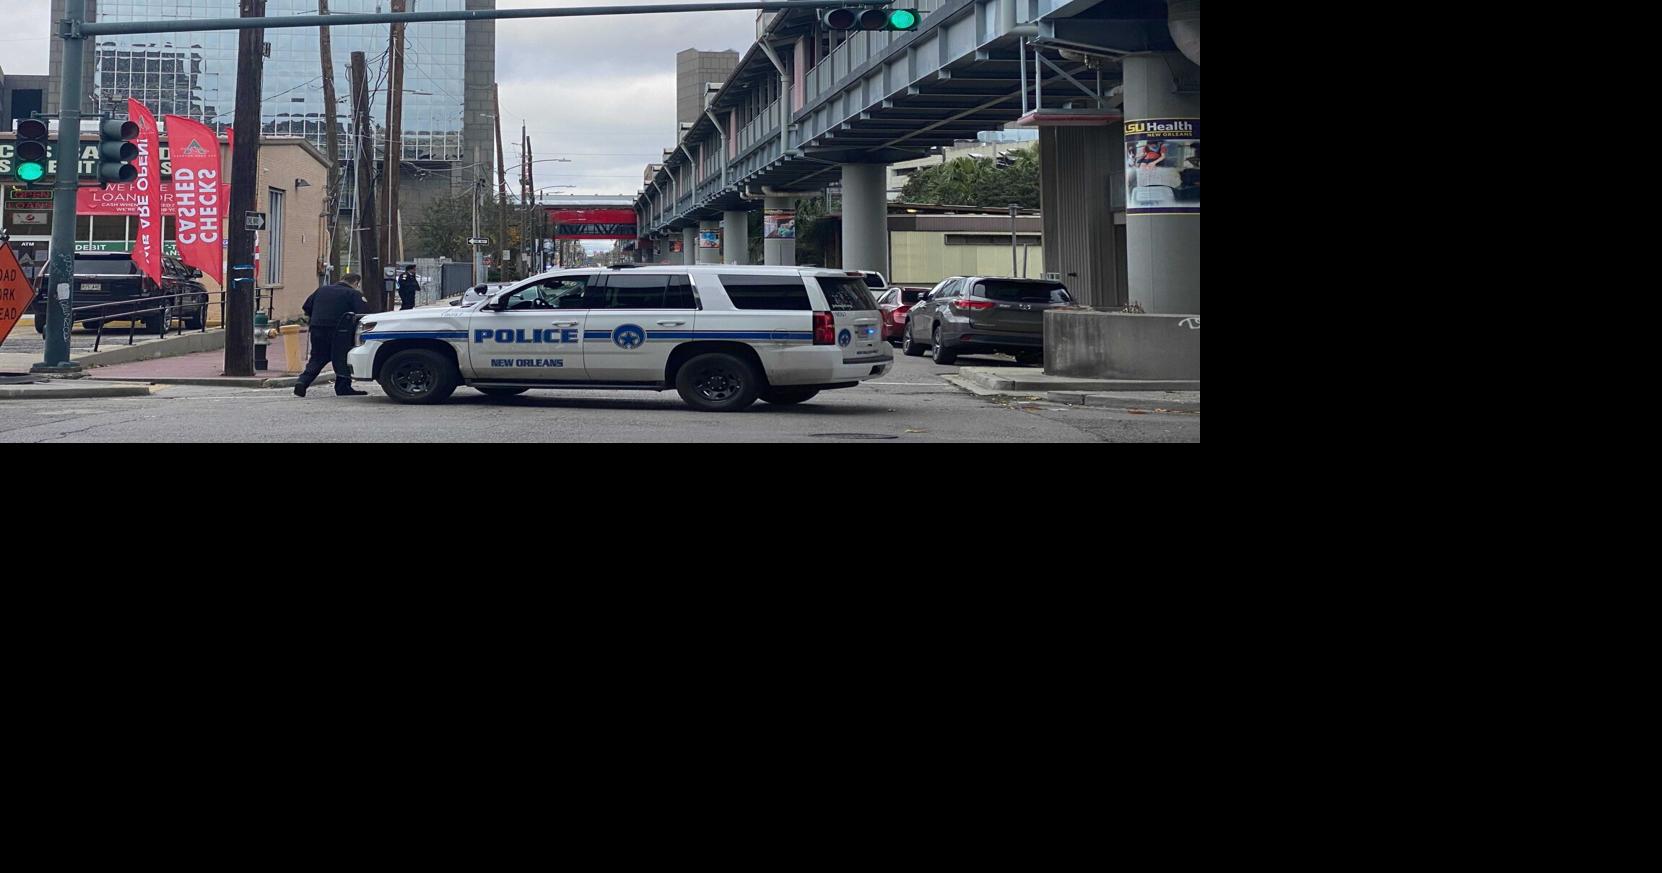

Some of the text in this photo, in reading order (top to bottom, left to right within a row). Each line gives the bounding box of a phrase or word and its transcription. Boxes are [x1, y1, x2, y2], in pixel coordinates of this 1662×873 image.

[1125, 121, 1193, 133] LSU Health
[474, 329, 579, 343] POLICE
[491, 358, 563, 367] NEW ORLEANS
